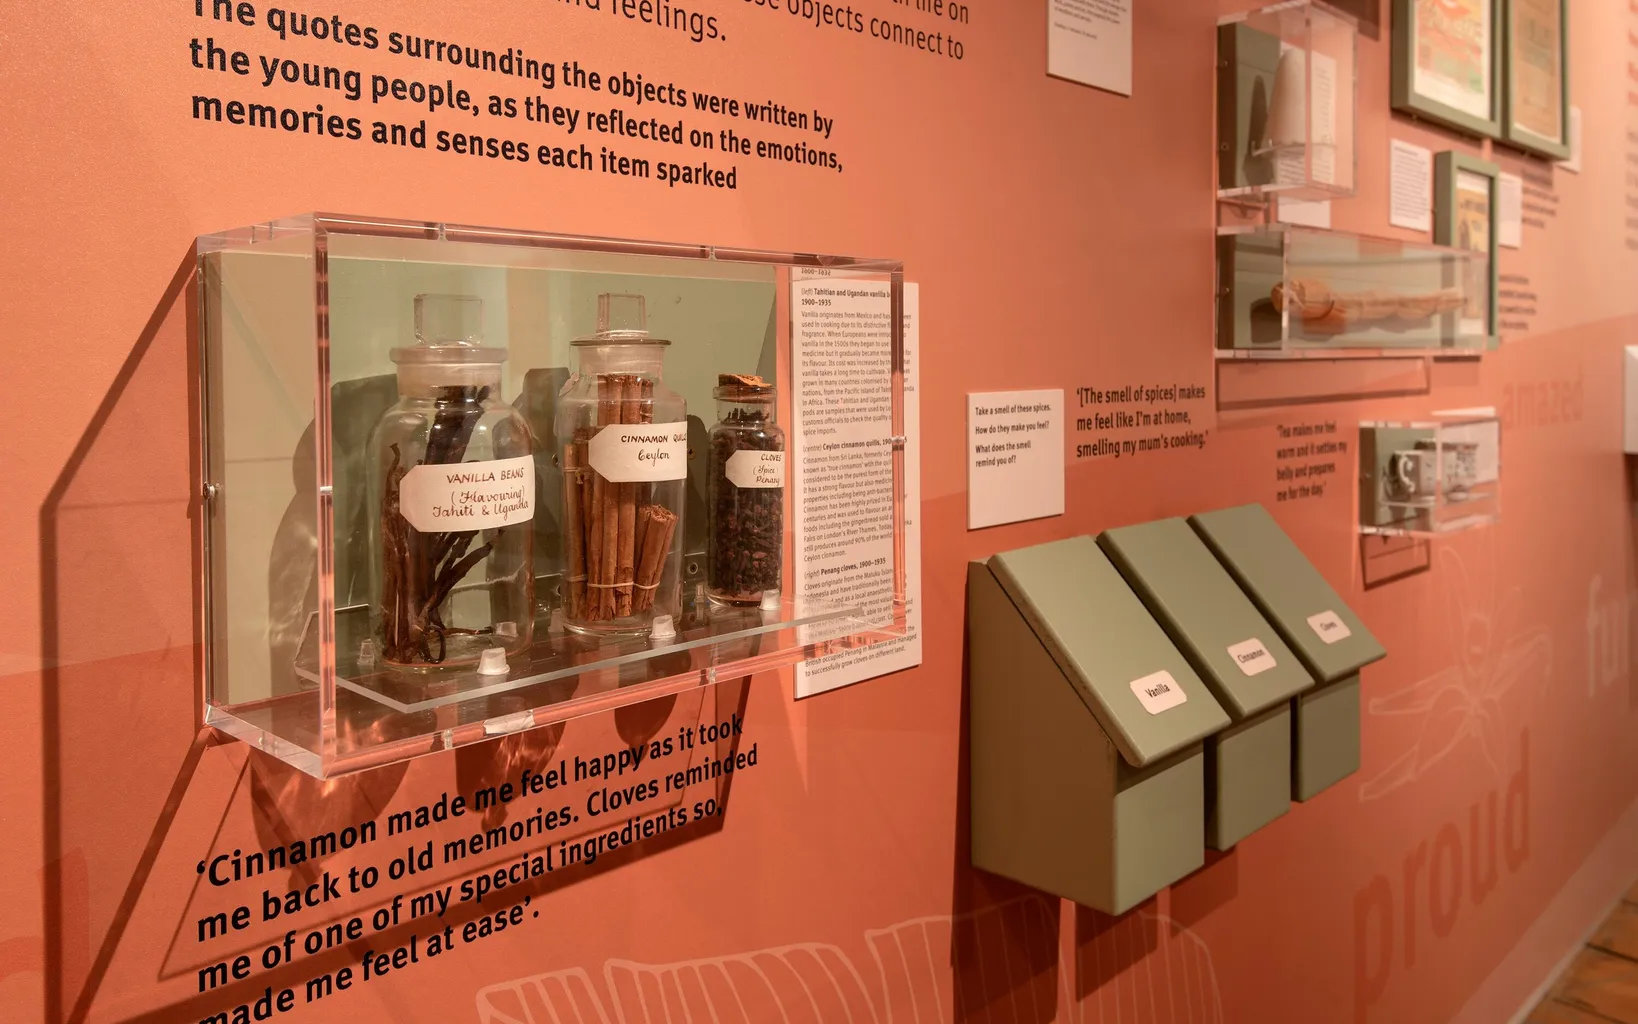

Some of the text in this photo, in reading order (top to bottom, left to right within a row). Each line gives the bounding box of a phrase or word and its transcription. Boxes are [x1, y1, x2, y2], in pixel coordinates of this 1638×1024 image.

[948, 2, 969, 25] on
[787, 0, 864, 33] objects
[870, 17, 943, 55] connect
[947, 35, 964, 60] to
[266, 8, 379, 50] quotes
[388, 31, 555, 90] surrounding
[562, 61, 601, 92] the
[607, 71, 687, 108] objects
[692, 92, 739, 117] were
[744, 100, 808, 130] written
[813, 109, 833, 140] by
[189, 37, 843, 173] the young people, as they reflected on the emotions,
[192, 95, 737, 190] memories and senses each item sparked
[814, 287, 836, 297] Tahitian
[837, 289, 847, 297] and
[847, 289, 869, 298] Ugandan
[870, 290, 886, 298] vanilla
[1105, 386, 1132, 403] smell
[1134, 384, 1144, 401] of
[1145, 384, 1177, 405] spices]
[1178, 384, 1205, 398] makes
[975, 406, 989, 416] Take
[994, 405, 1010, 415] smell
[1010, 405, 1017, 413] of
[1017, 405, 1032, 413] these
[1033, 403, 1051, 413] spices.
[1077, 417, 1092, 431] me
[1095, 412, 1114, 430] feel
[1116, 411, 1133, 428] like
[1153, 410, 1162, 425] at
[1164, 408, 1191, 425] home,
[975, 420, 1050, 435] How do they make you feel?
[620, 434, 669, 444] CINNAMON
[822, 442, 841, 452] Ceylon
[841, 440, 866, 450] cinnamon
[975, 440, 1031, 454] What does the smell
[1077, 438, 1120, 458] smelling
[1122, 440, 1137, 456] my
[637, 448, 670, 467] Ceylon
[760, 453, 782, 462] CLOVES
[975, 455, 1017, 468] remind you of?
[446, 467, 525, 484] VANILLA BEANS
[756, 475, 780, 487] Penang
[432, 499, 530, 522] Tahiti & Uganda
[820, 566, 841, 576] Penang
[805, 658, 822, 668] British
[822, 652, 845, 664] occupied
[845, 648, 863, 659] Penang
[868, 640, 888, 652] Malaysia
[888, 638, 898, 647] and
[897, 633, 918, 644] managed
[1236, 647, 1266, 665] Cinnamon
[805, 670, 812, 678] to
[811, 661, 841, 675] successfully
[841, 660, 853, 670] grow
[853, 654, 869, 665] cloves
[868, 653, 876, 661] on
[875, 648, 895, 659] different
[1144, 682, 1172, 700] Vanilla
[388, 792, 466, 836] made
[475, 782, 513, 811] me
[520, 760, 567, 797] feel
[574, 745, 644, 781] happy
[650, 737, 673, 760] as
[679, 727, 694, 751] it
[699, 713, 742, 745] took
[198, 744, 757, 942] me back to old memories. Cloves reminded
[1352, 726, 1530, 1024] proud
[198, 799, 723, 993] me of one of my special ingredients so,
[306, 967, 353, 1003] me
[362, 934, 419, 981] feel
[427, 925, 454, 957] at
